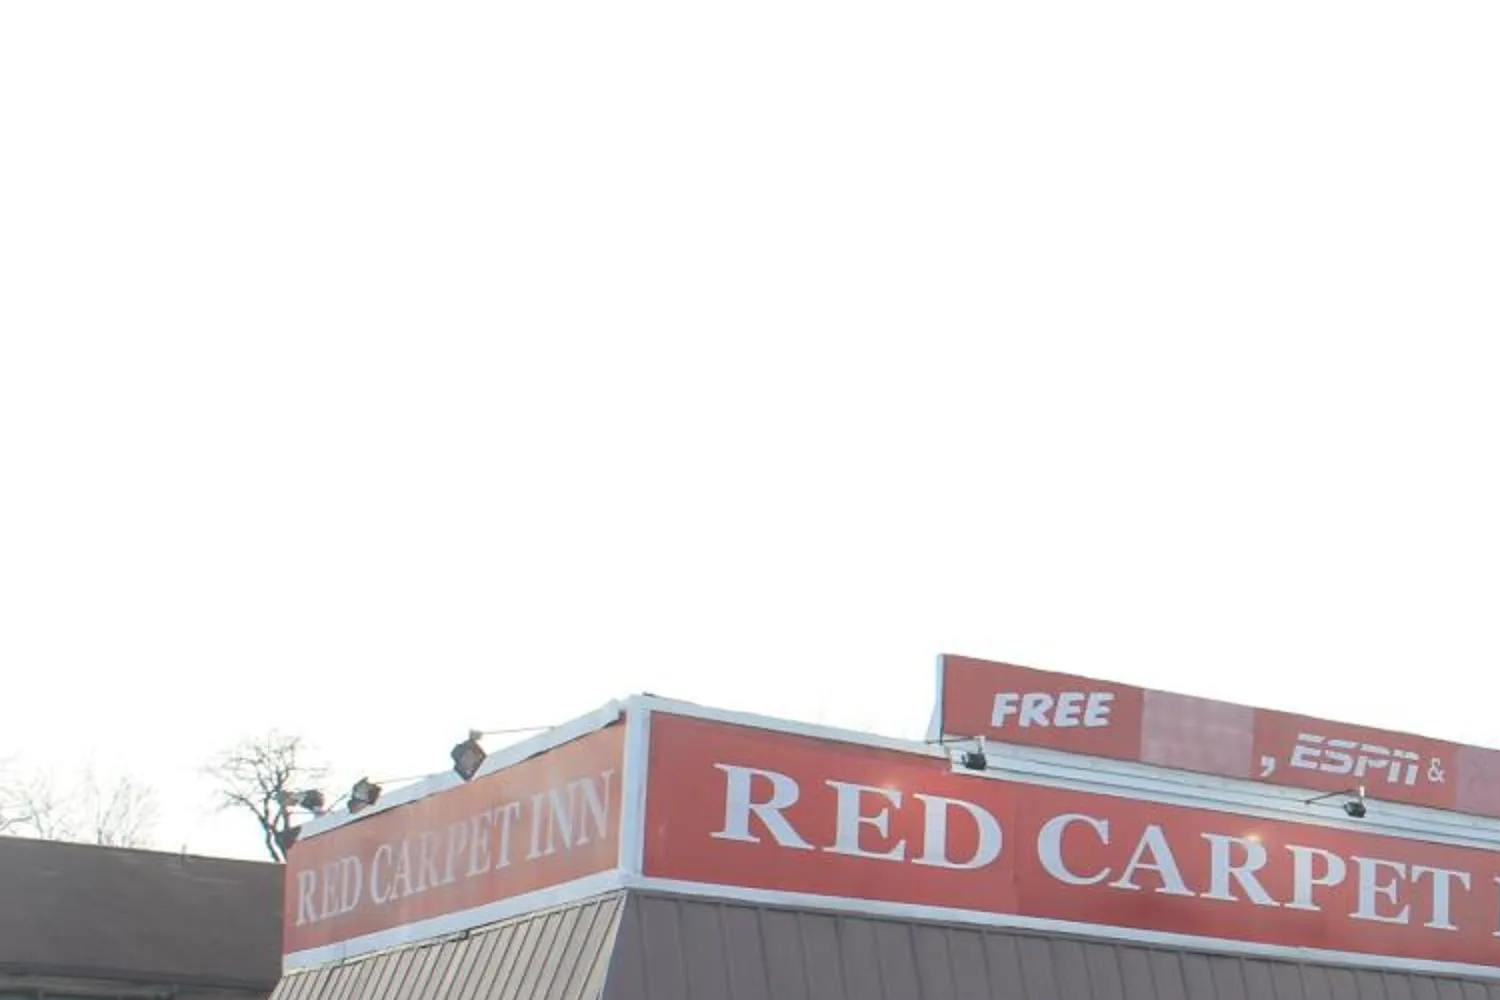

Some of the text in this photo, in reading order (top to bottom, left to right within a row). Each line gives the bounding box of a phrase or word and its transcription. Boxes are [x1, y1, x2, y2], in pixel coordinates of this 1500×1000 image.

[990, 692, 1113, 728] FREE
[1290, 733, 1419, 785] ESPN
[296, 771, 615, 926] RED CARPET INN
[710, 763, 1003, 870] RED
[1036, 813, 1471, 931] CARPET
